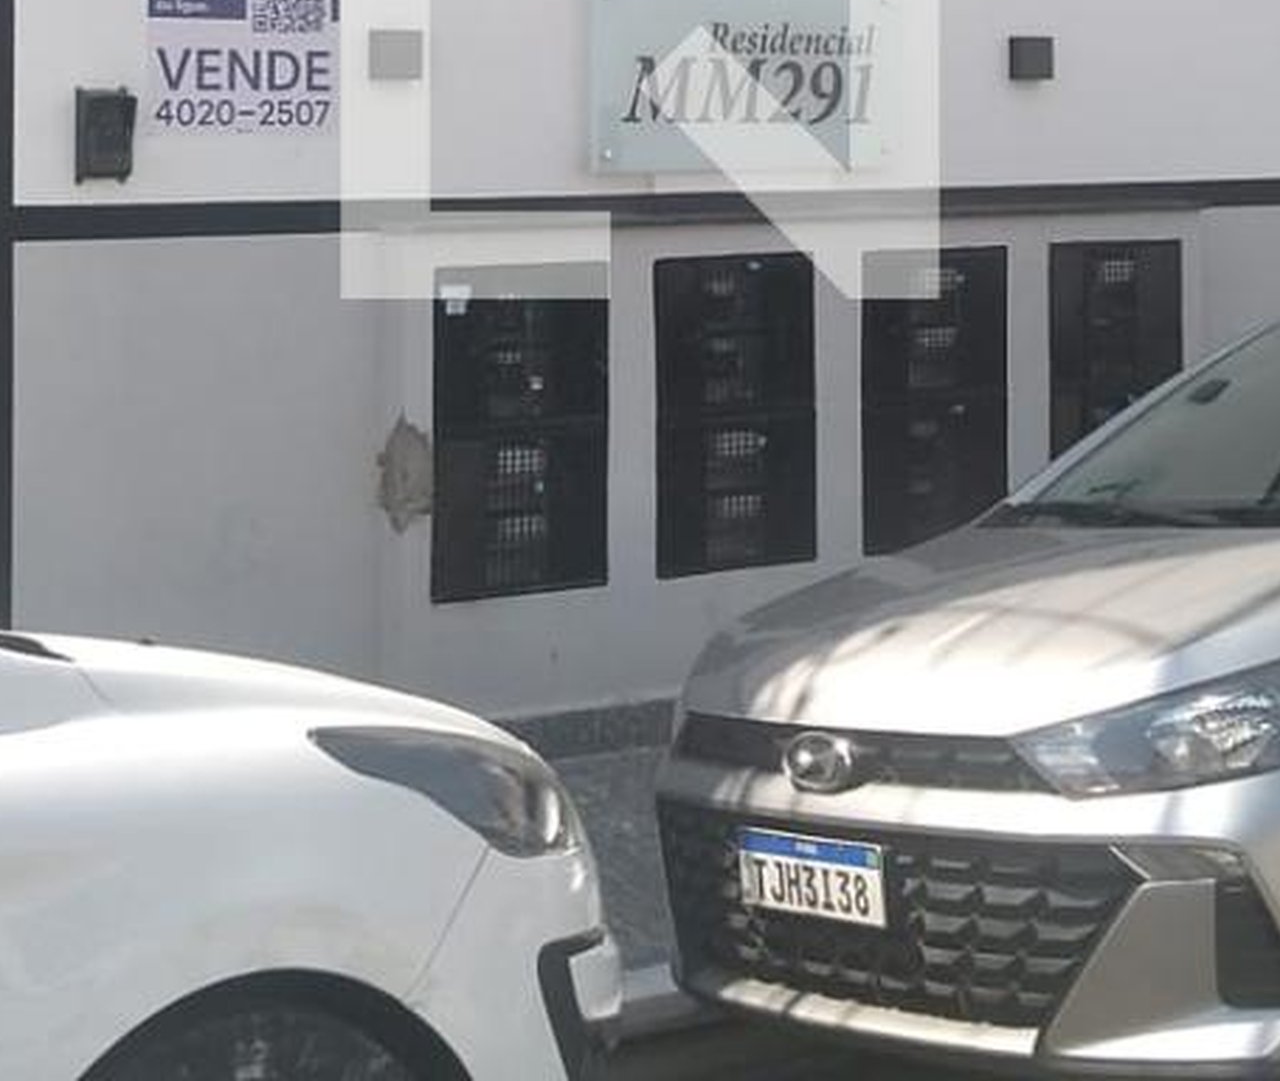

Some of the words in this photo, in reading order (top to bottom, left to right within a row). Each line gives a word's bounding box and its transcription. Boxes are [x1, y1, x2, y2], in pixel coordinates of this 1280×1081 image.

[708, 22, 874, 55] Residencial
[157, 48, 331, 91] VENDE
[621, 56, 874, 125] MM291
[155, 99, 331, 126] 4020-2507
